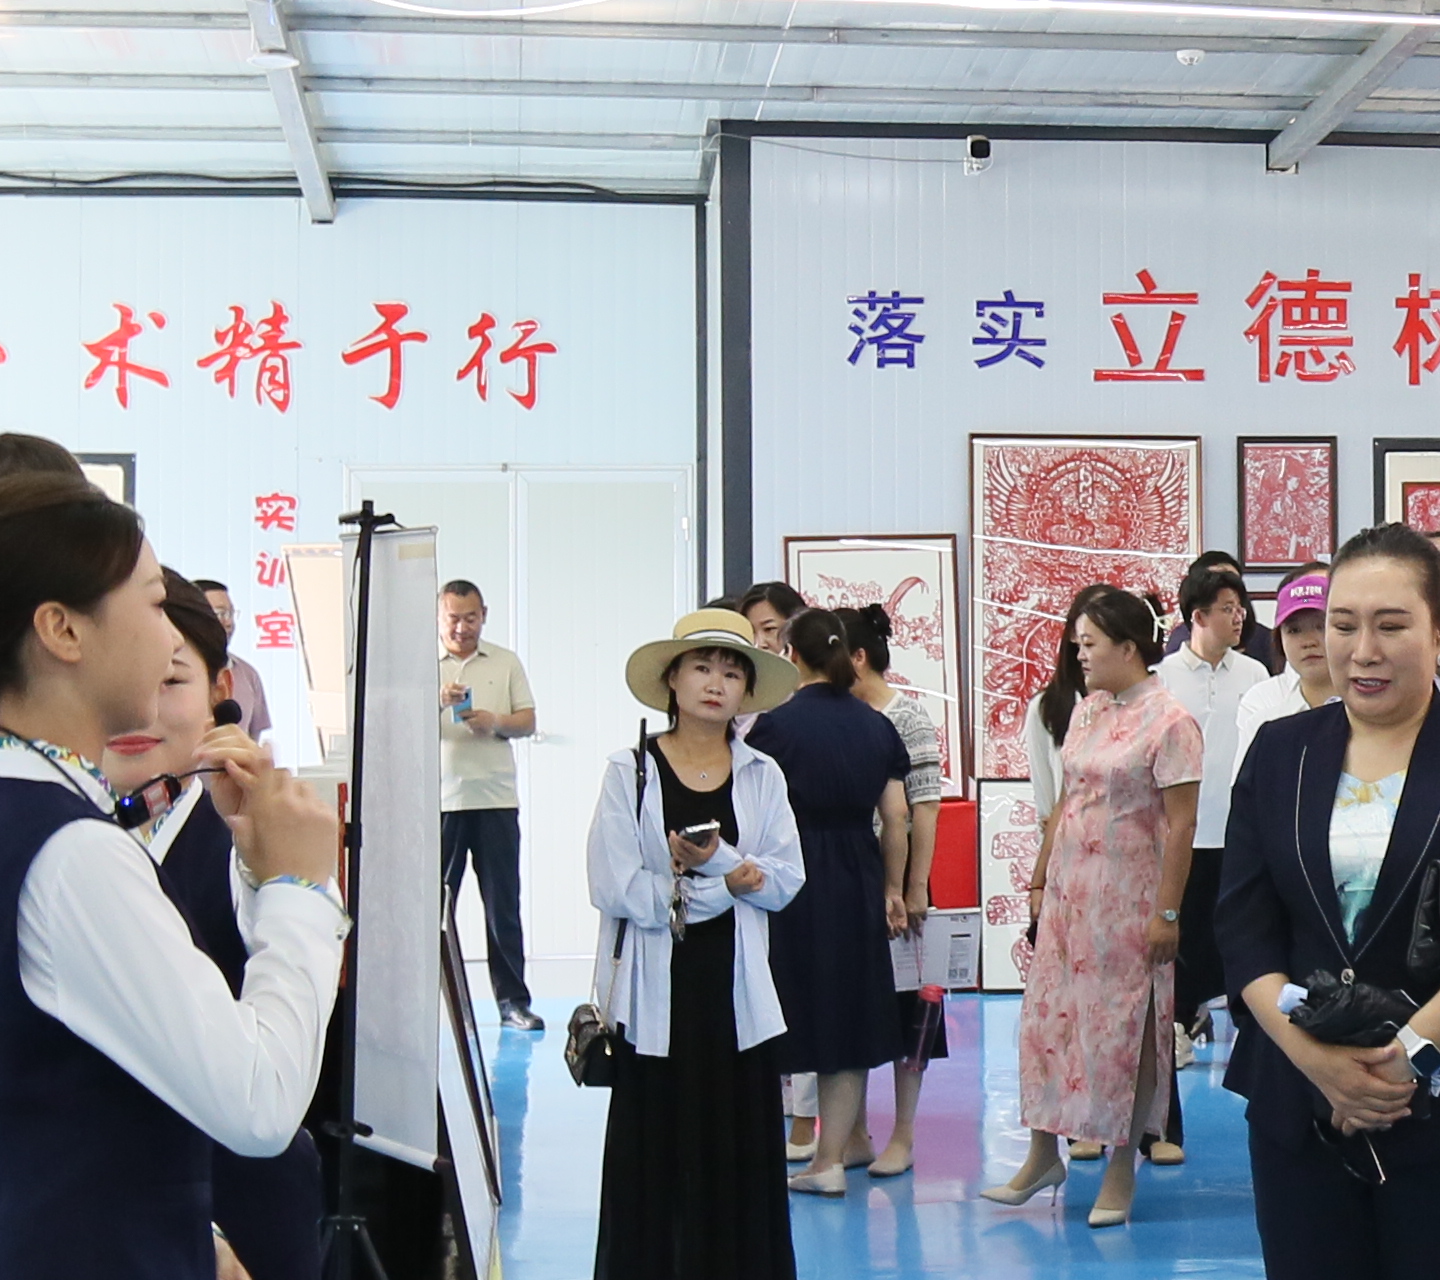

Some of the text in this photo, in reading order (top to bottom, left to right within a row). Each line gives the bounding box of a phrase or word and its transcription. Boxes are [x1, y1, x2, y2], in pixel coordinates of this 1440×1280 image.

[82, 301, 558, 413] 术精于行
[254, 492, 297, 649] 实训室
